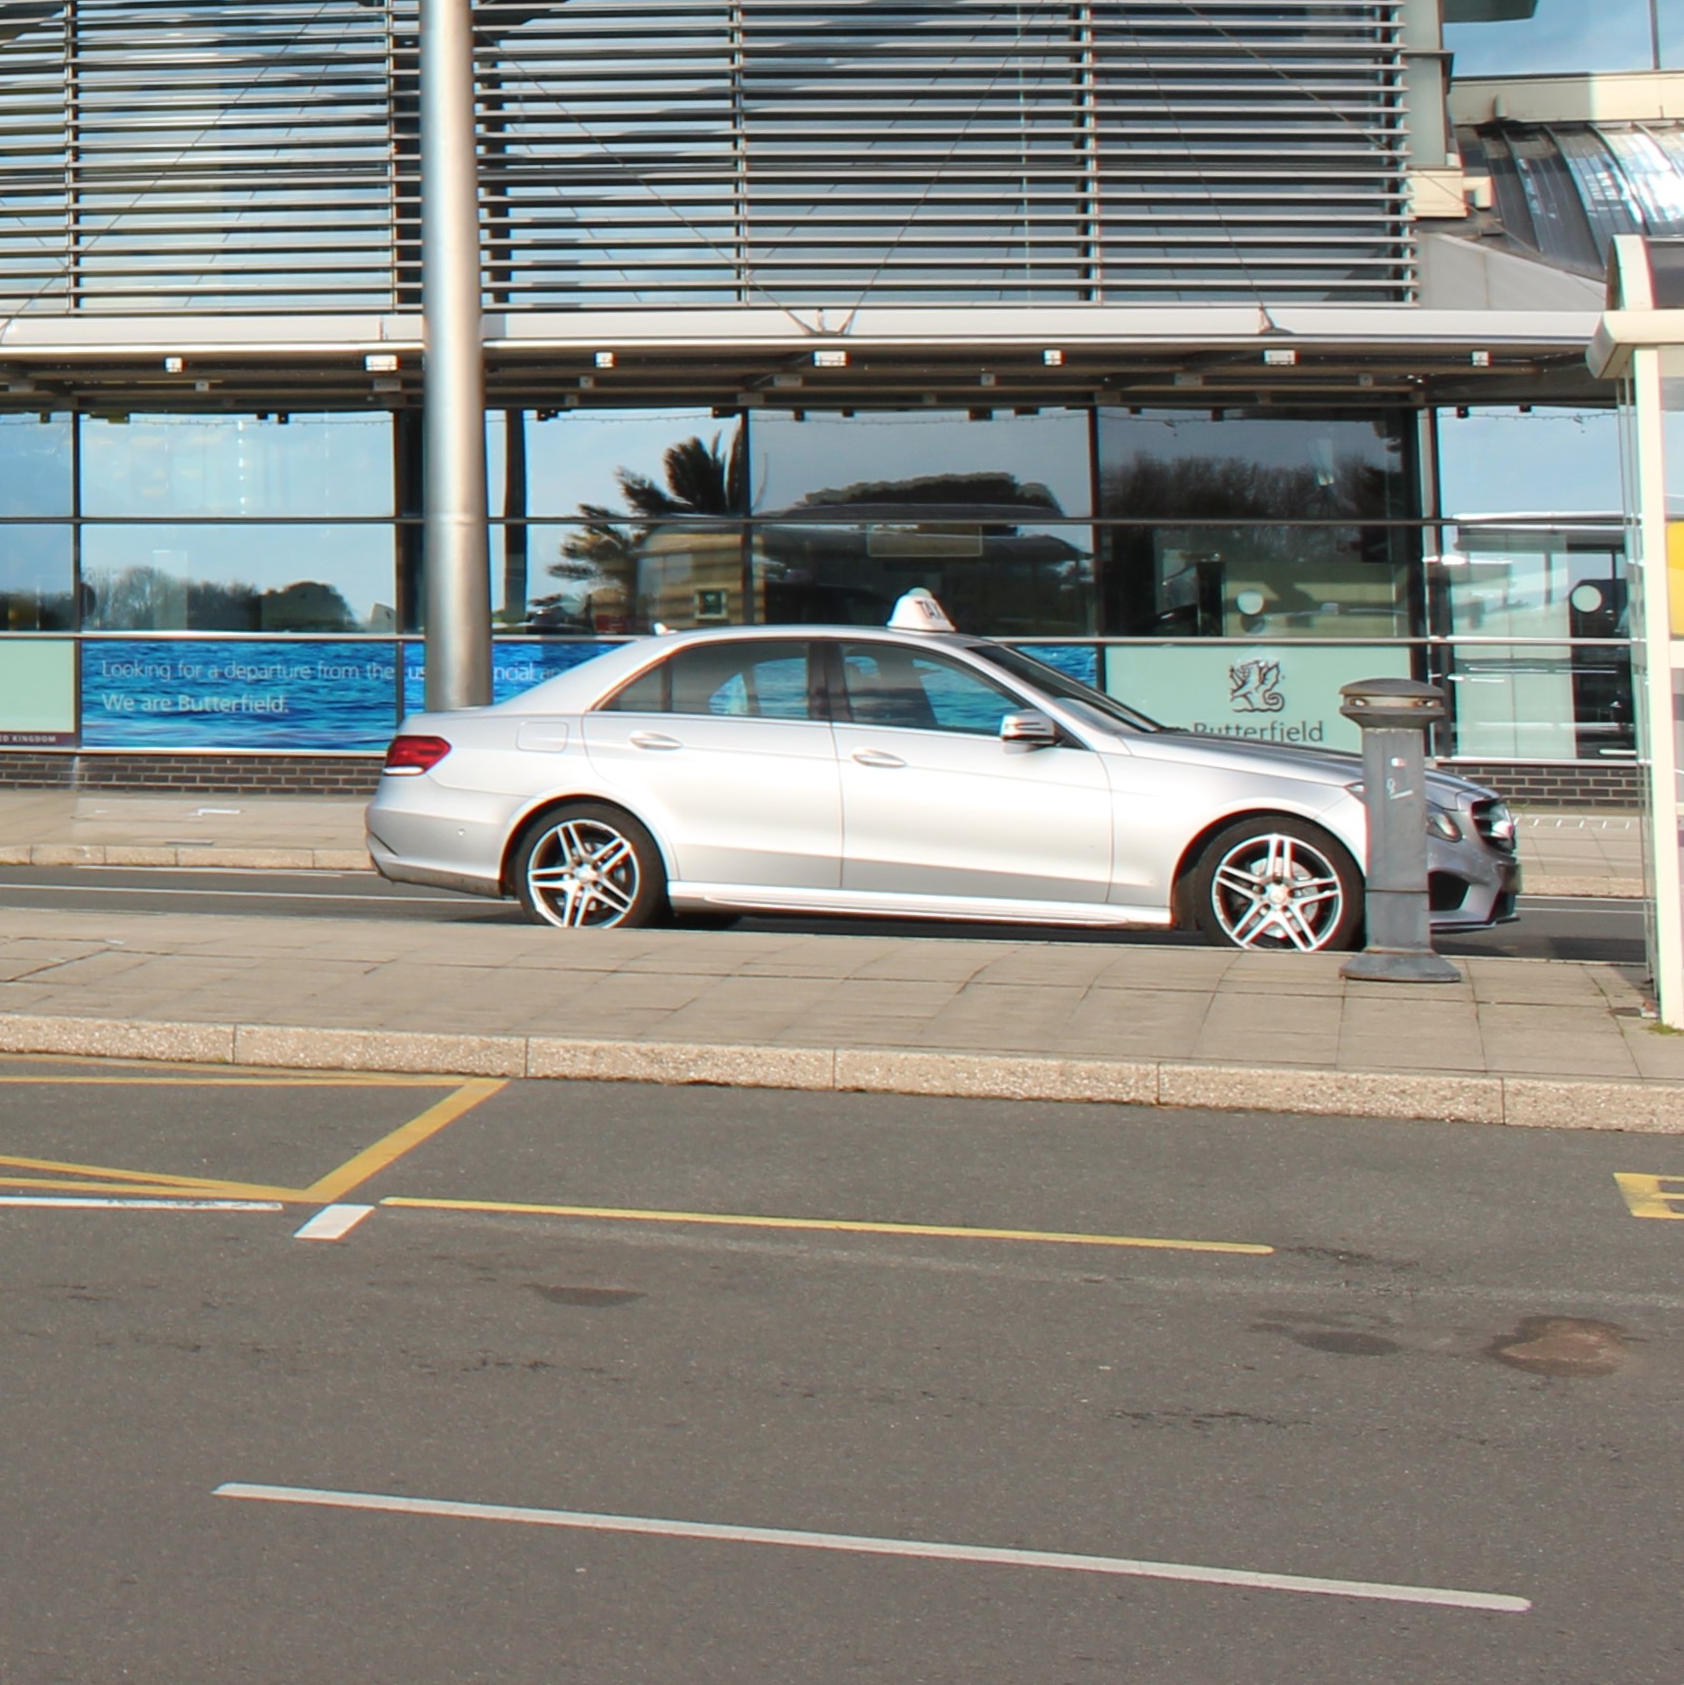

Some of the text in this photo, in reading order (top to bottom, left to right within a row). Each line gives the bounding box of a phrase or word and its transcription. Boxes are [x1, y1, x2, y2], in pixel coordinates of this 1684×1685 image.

[102, 660, 172, 682] Looking
[178, 660, 203, 678] for
[207, 665, 219, 679] a
[223, 661, 312, 683] departure
[316, 661, 361, 680] from
[366, 662, 395, 680] the
[102, 693, 290, 714] We are Butterfield.
[12, 734, 57, 743] KINGDOM
